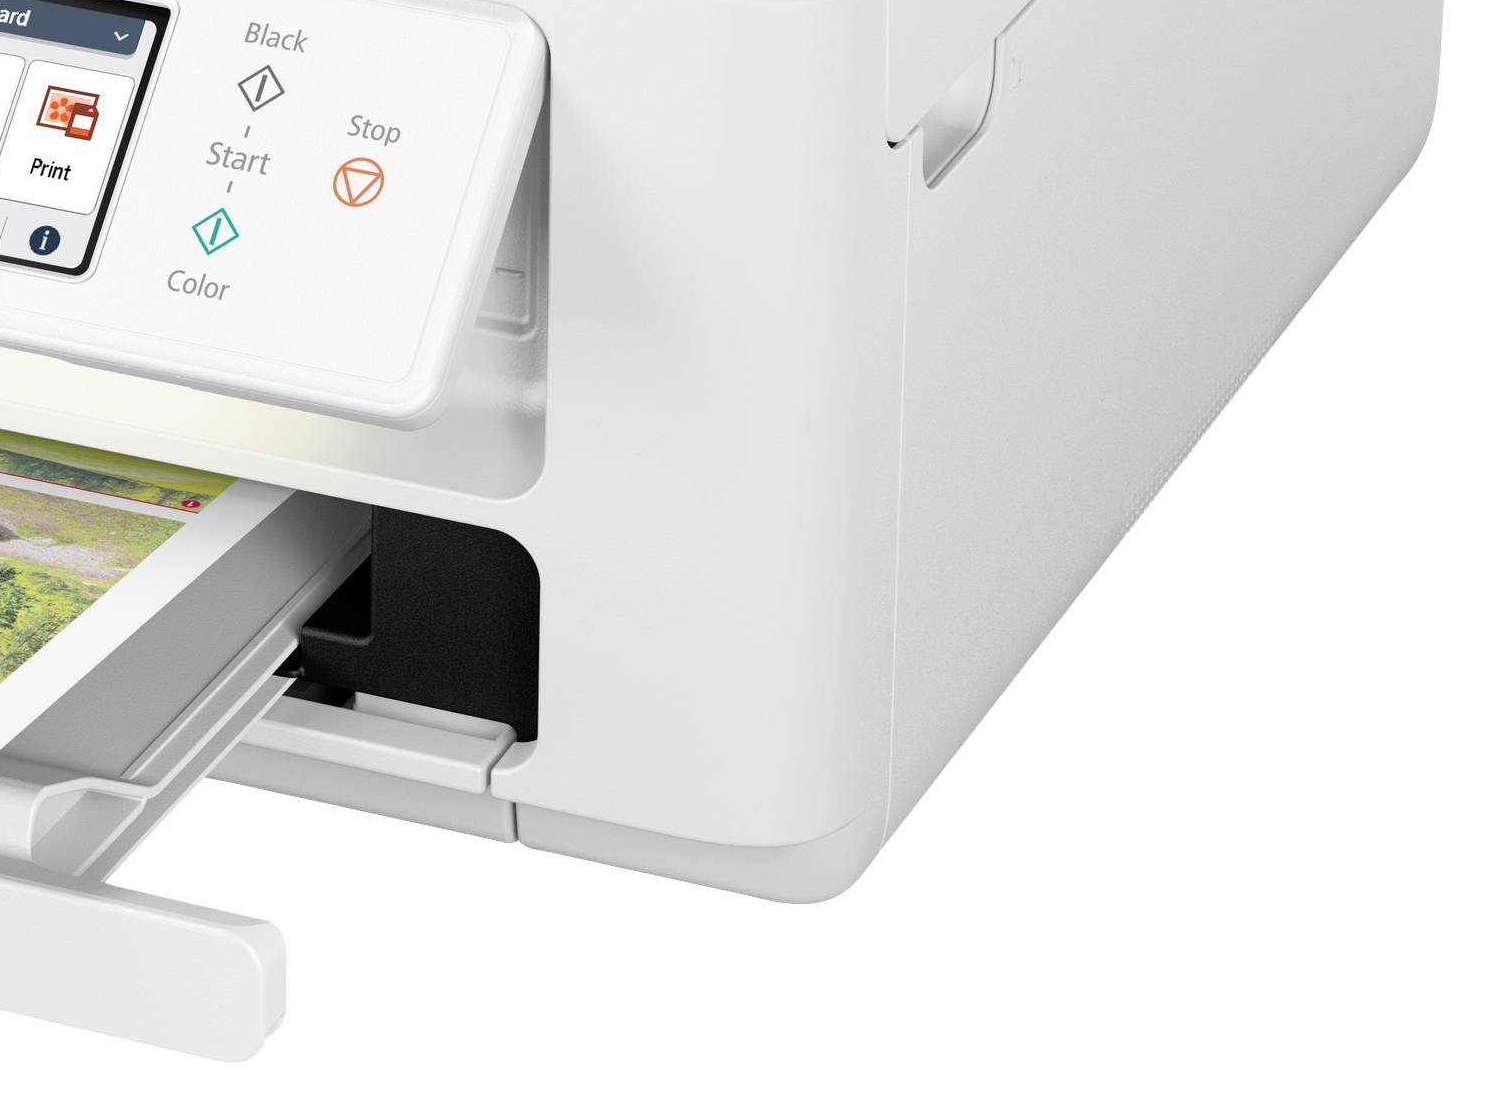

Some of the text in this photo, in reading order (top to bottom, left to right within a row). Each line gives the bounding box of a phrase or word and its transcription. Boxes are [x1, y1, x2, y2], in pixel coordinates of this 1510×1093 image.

[243, 21, 309, 53] Black
[347, 114, 402, 147] Stop
[29, 157, 72, 182] Print
[205, 141, 271, 176] Start
[166, 269, 231, 301] Color
